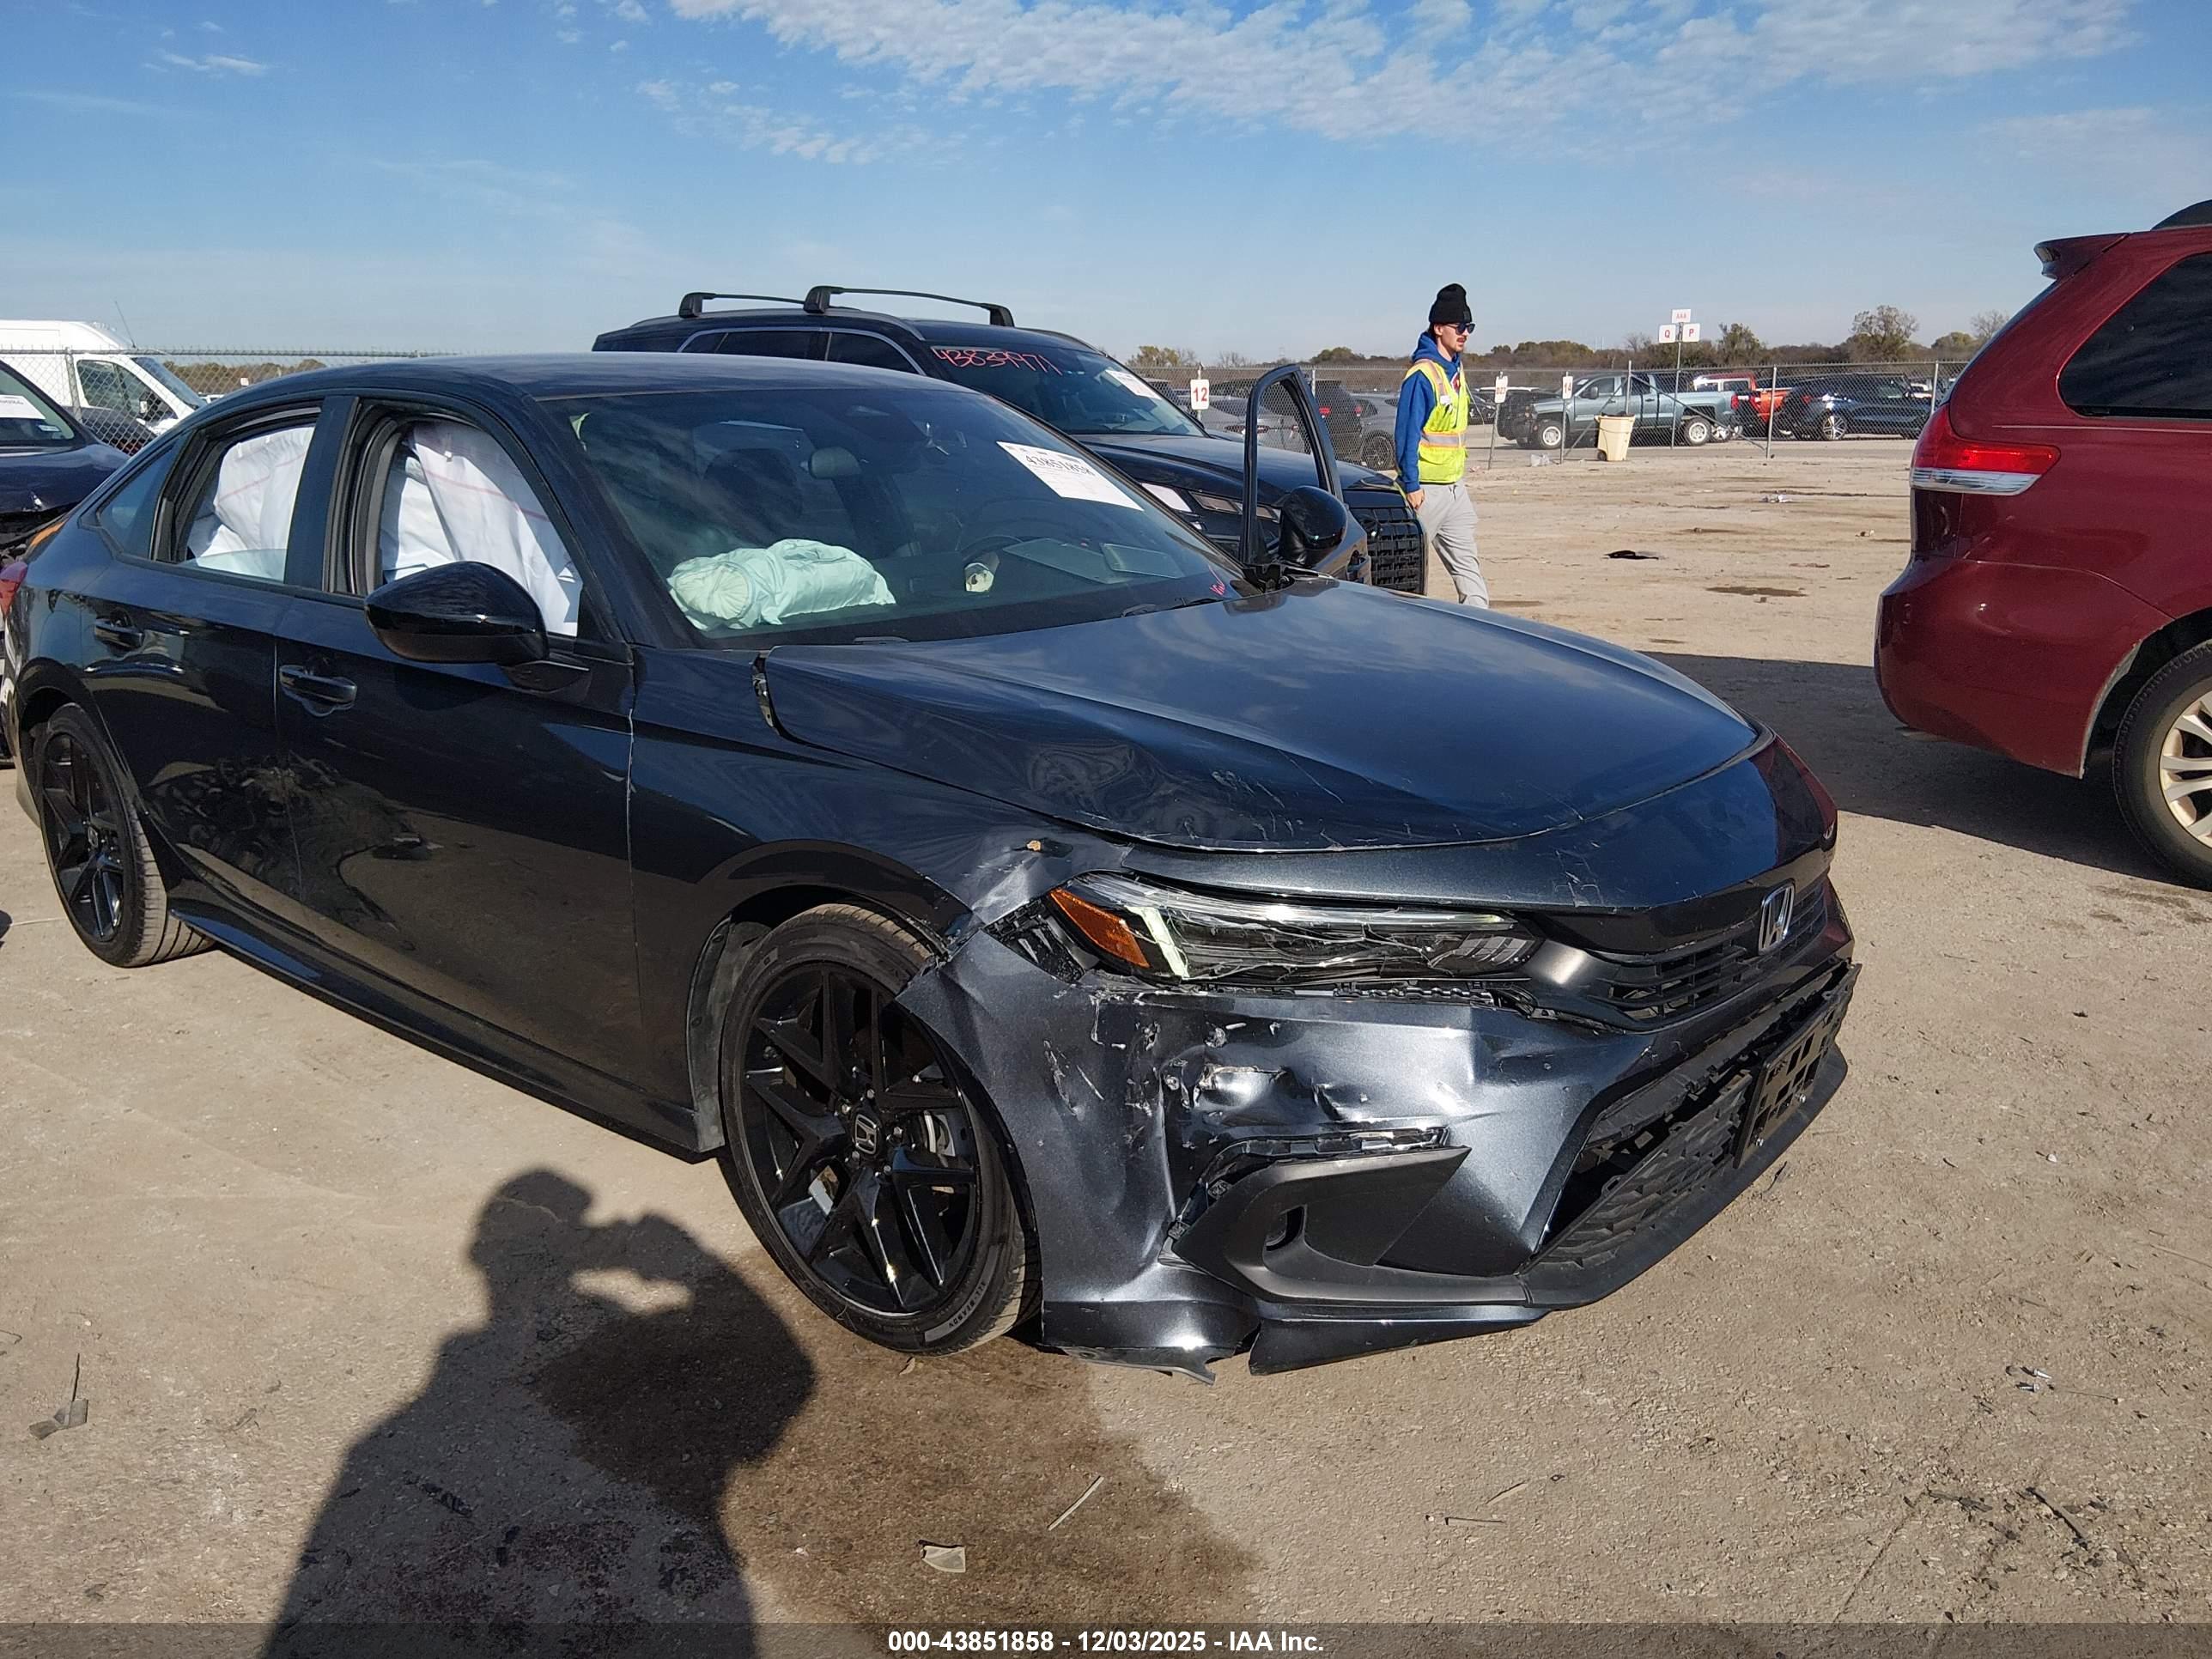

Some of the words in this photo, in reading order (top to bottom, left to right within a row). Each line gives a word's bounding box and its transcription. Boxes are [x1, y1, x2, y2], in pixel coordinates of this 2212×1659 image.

[1664, 329, 1671, 338] Q
[1688, 328, 1694, 337] P
[1564, 382, 1571, 393] 14
[1193, 387, 1207, 402] 12
